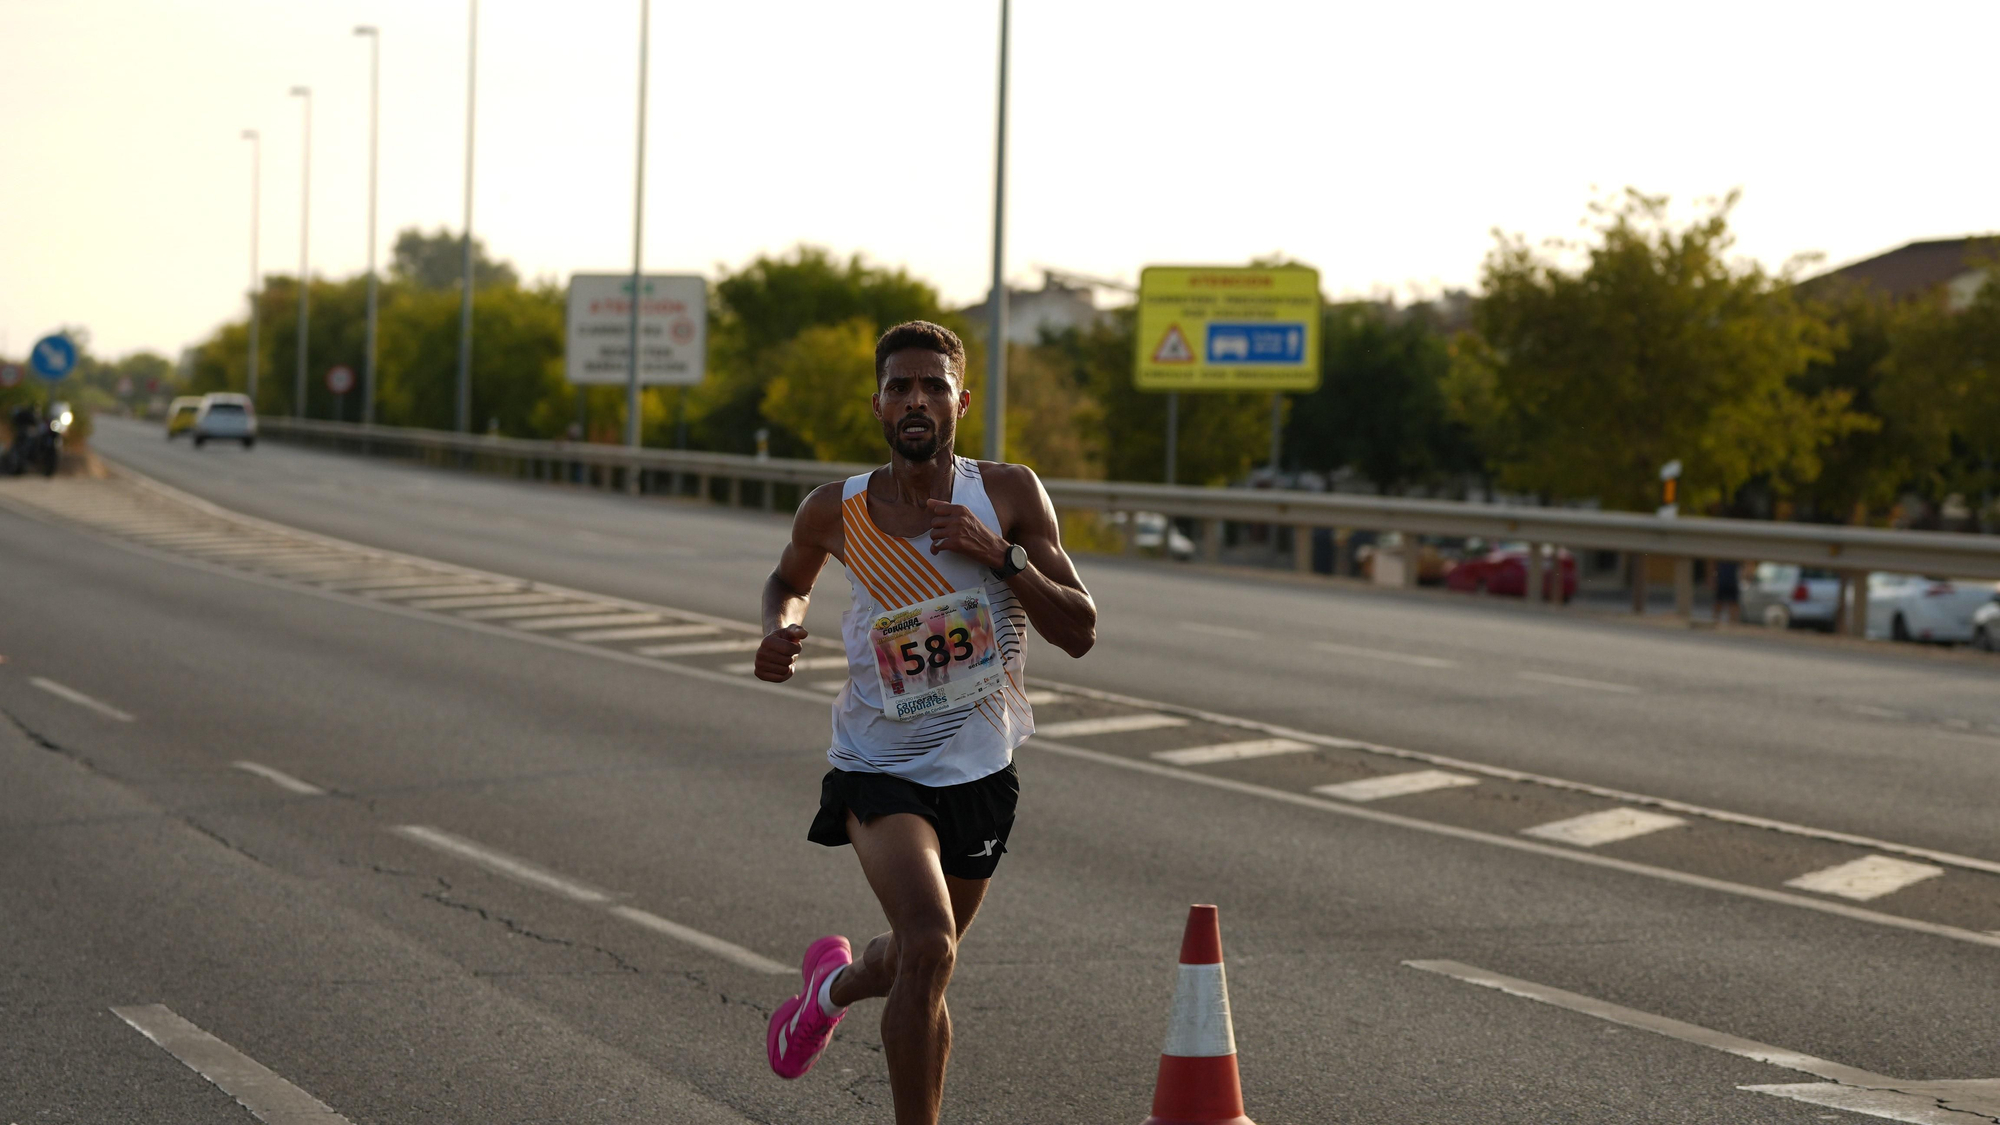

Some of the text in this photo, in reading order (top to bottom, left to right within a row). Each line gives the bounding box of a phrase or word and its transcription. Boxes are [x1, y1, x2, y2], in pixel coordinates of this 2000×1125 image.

[900, 627, 973, 676] 583
[896, 693, 938, 709] carreras
[898, 695, 947, 717] populares
